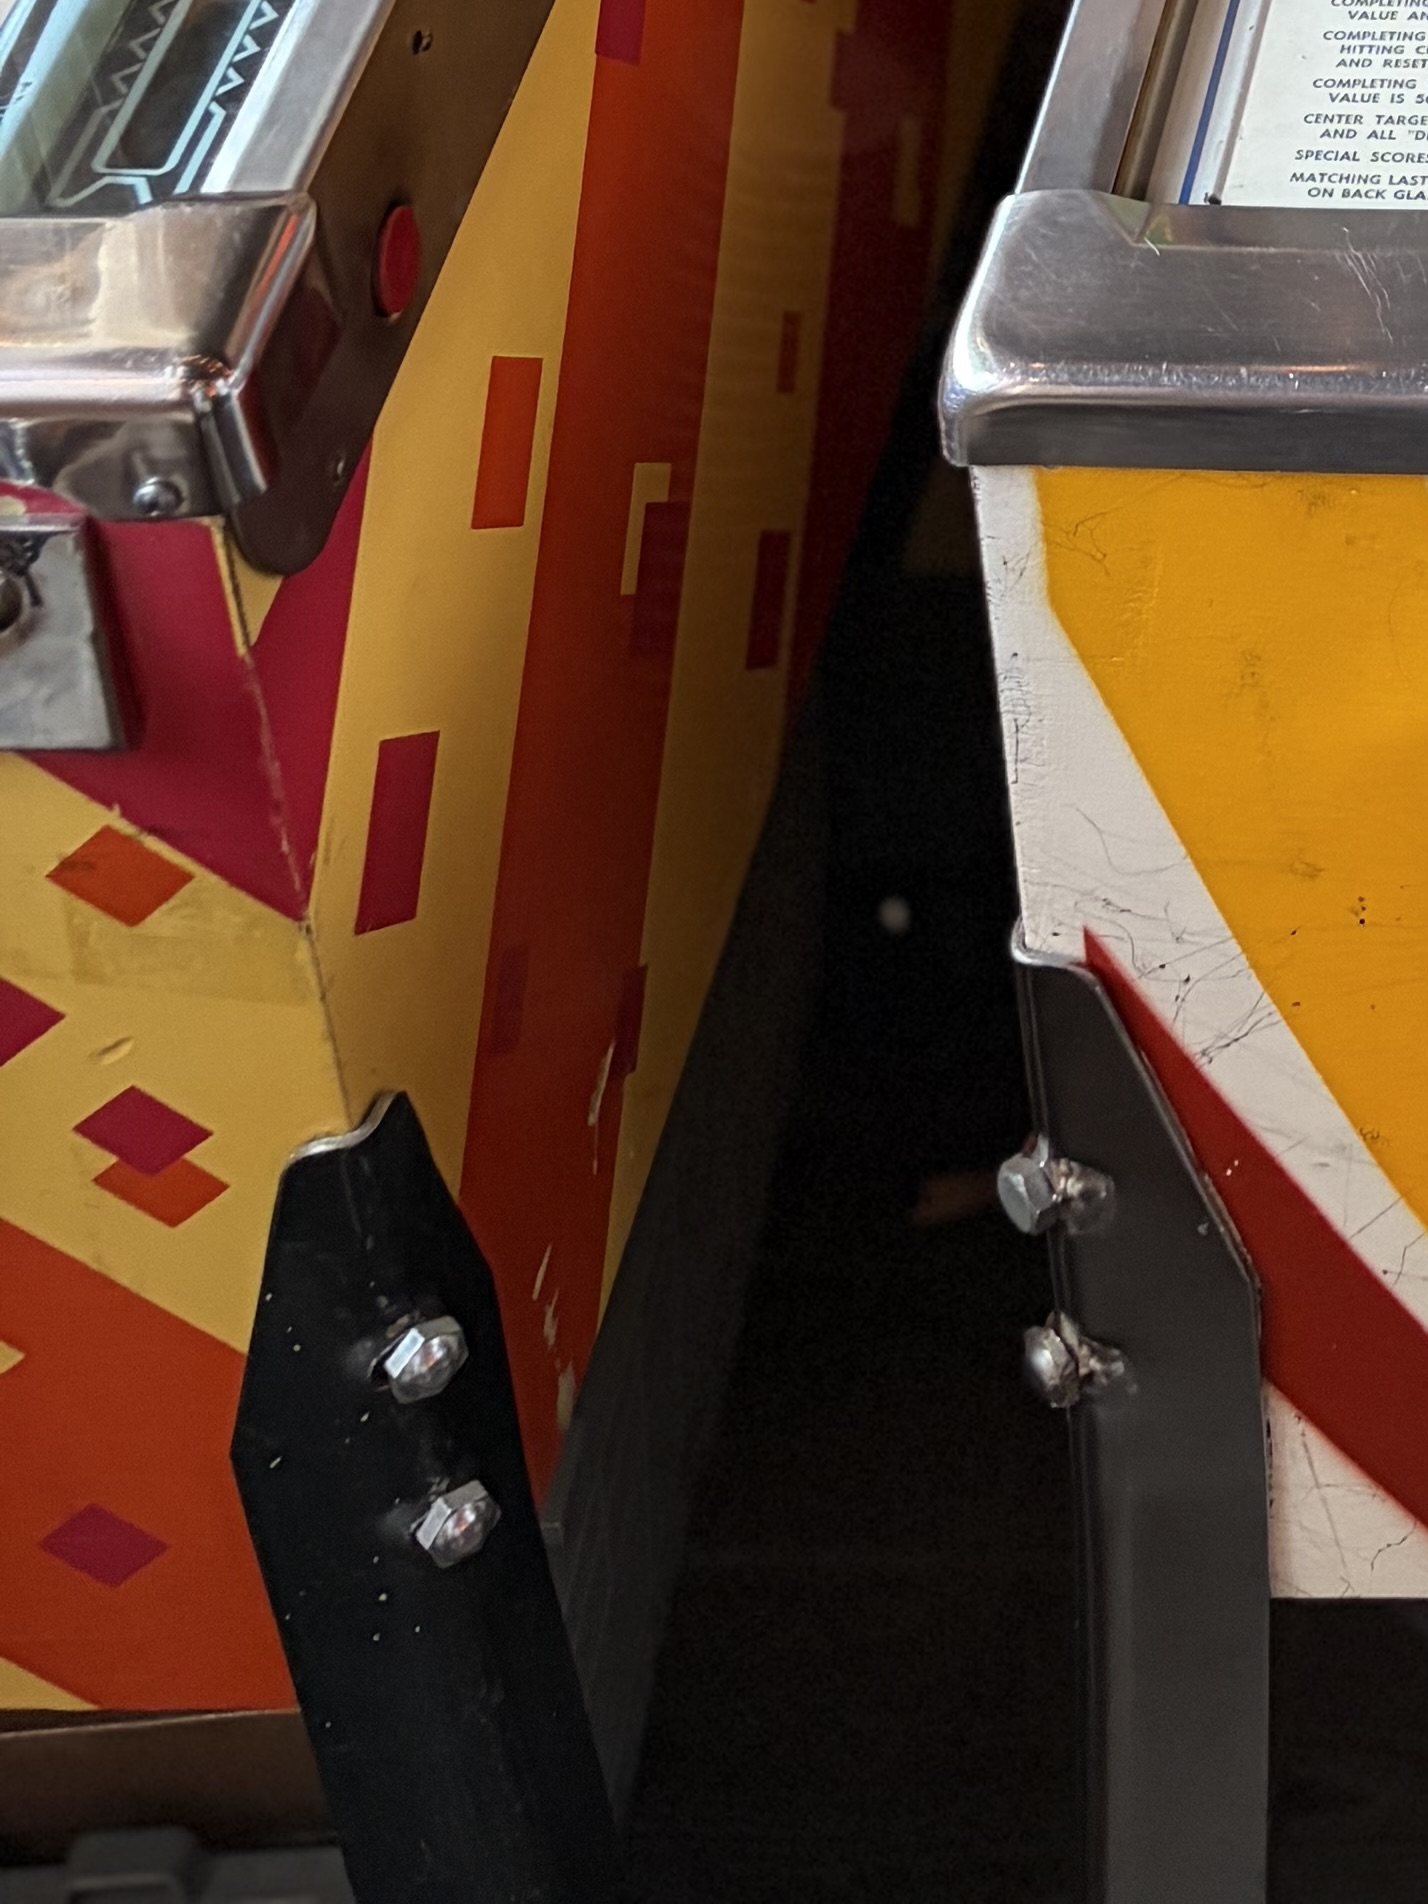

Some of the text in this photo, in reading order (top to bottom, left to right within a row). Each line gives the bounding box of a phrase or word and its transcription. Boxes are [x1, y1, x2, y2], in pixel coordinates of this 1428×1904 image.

[1348, 11, 1398, 21] VALUE
[1328, 93, 1380, 104] VALUE
[1390, 93, 1405, 104] IS
[1294, 149, 1361, 162] SPECIAL
[1307, 187, 1334, 199] ON
[1341, 188, 1387, 200] BACK
